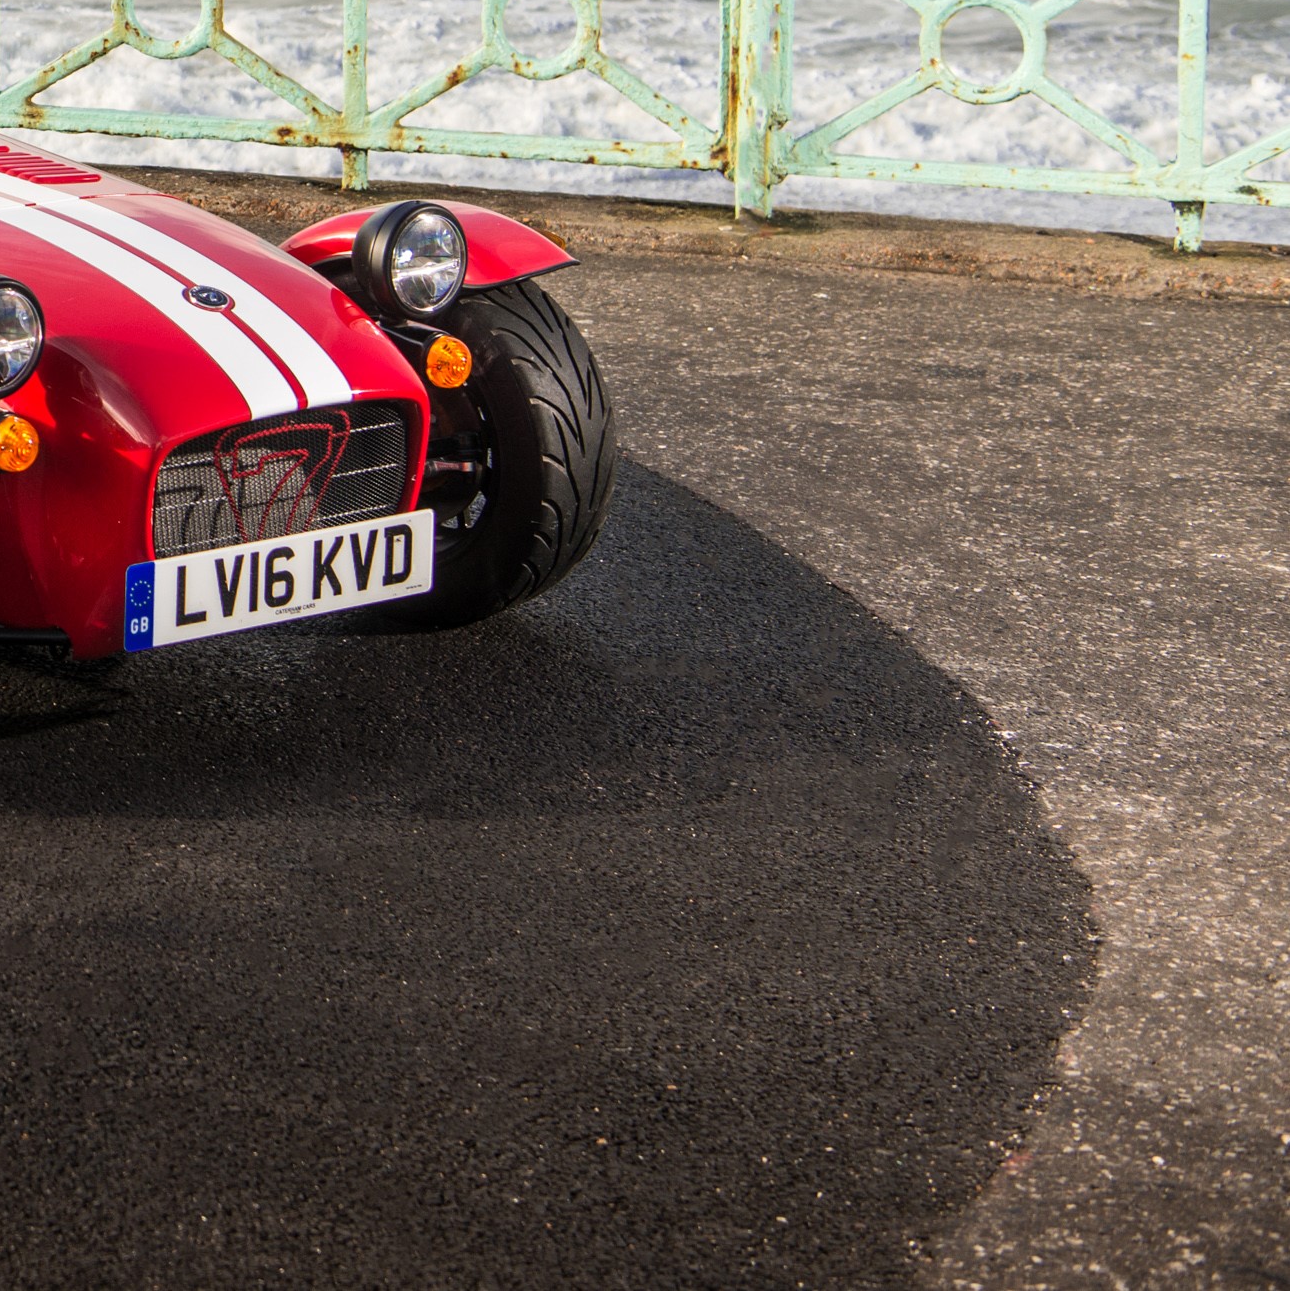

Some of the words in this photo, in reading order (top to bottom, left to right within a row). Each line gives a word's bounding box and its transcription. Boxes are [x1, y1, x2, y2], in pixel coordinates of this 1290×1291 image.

[175, 546, 296, 627] LV16
[312, 523, 413, 601] KVD
[130, 616, 150, 635] GB
